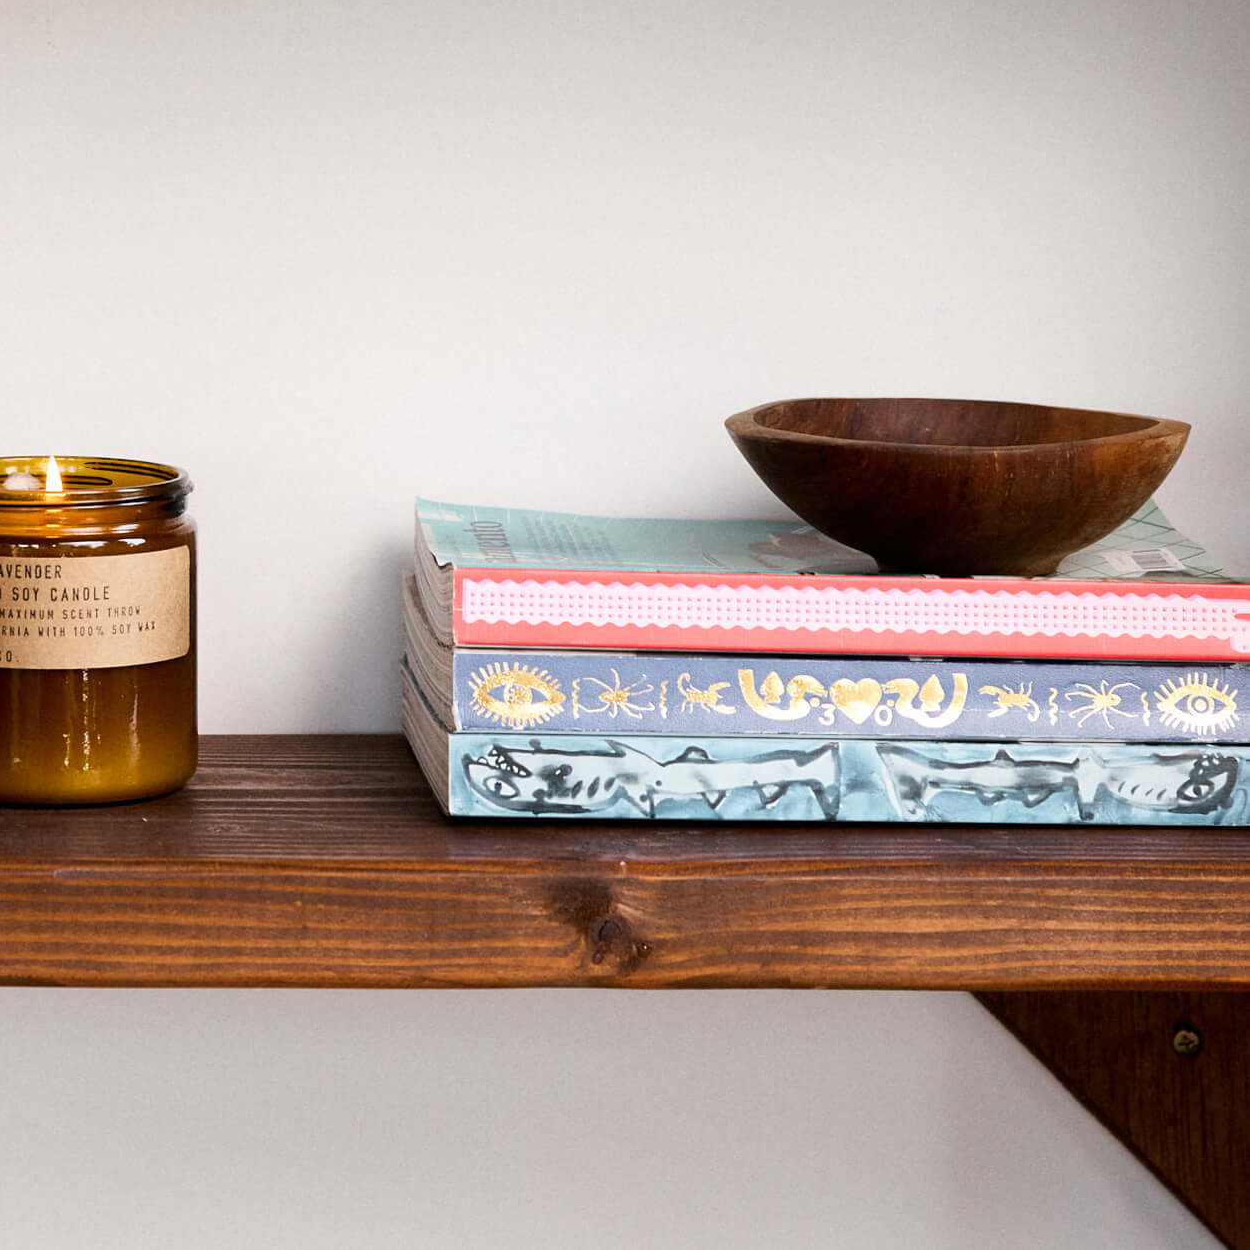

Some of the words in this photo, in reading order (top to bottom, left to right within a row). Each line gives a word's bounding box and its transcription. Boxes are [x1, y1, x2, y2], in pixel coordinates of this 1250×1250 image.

[11, 587, 39, 602] SOY
[50, 585, 110, 602] CANDLE
[62, 607, 100, 620] SCENT
[107, 605, 141, 618] THROW
[38, 626, 66, 637] WITH
[73, 625, 105, 637] 100%
[112, 623, 131, 635] SOY
[137, 620, 156, 632] WAX
